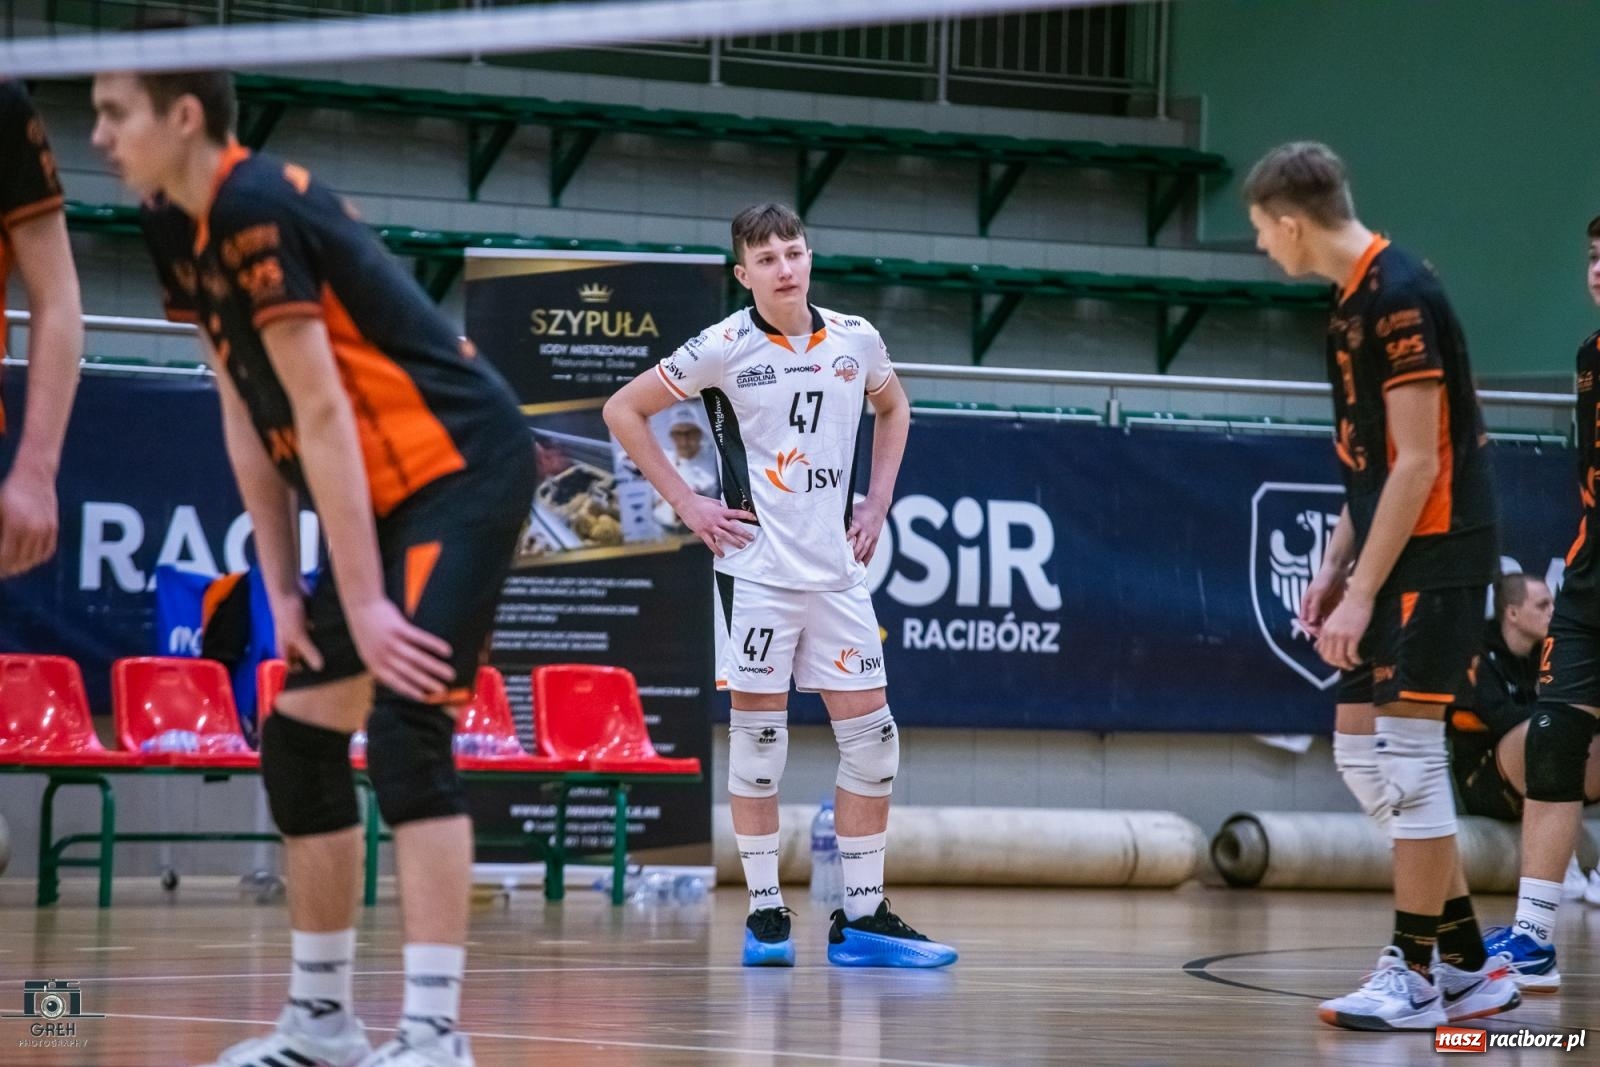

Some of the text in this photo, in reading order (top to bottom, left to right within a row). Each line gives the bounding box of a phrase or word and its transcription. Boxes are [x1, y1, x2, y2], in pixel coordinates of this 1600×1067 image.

[529, 308, 660, 338] SZYPUŁA
[736, 374, 777, 384] CAROLINA
[784, 365, 815, 374] DAMONS
[789, 390, 824, 434] 47
[805, 468, 843, 493] JSW
[903, 612, 1061, 653] RACIBÓRZ
[743, 627, 774, 662] 47
[739, 666, 768, 674] DAMONS
[859, 657, 882, 673] JSW
[846, 885, 884, 897] DAMO
